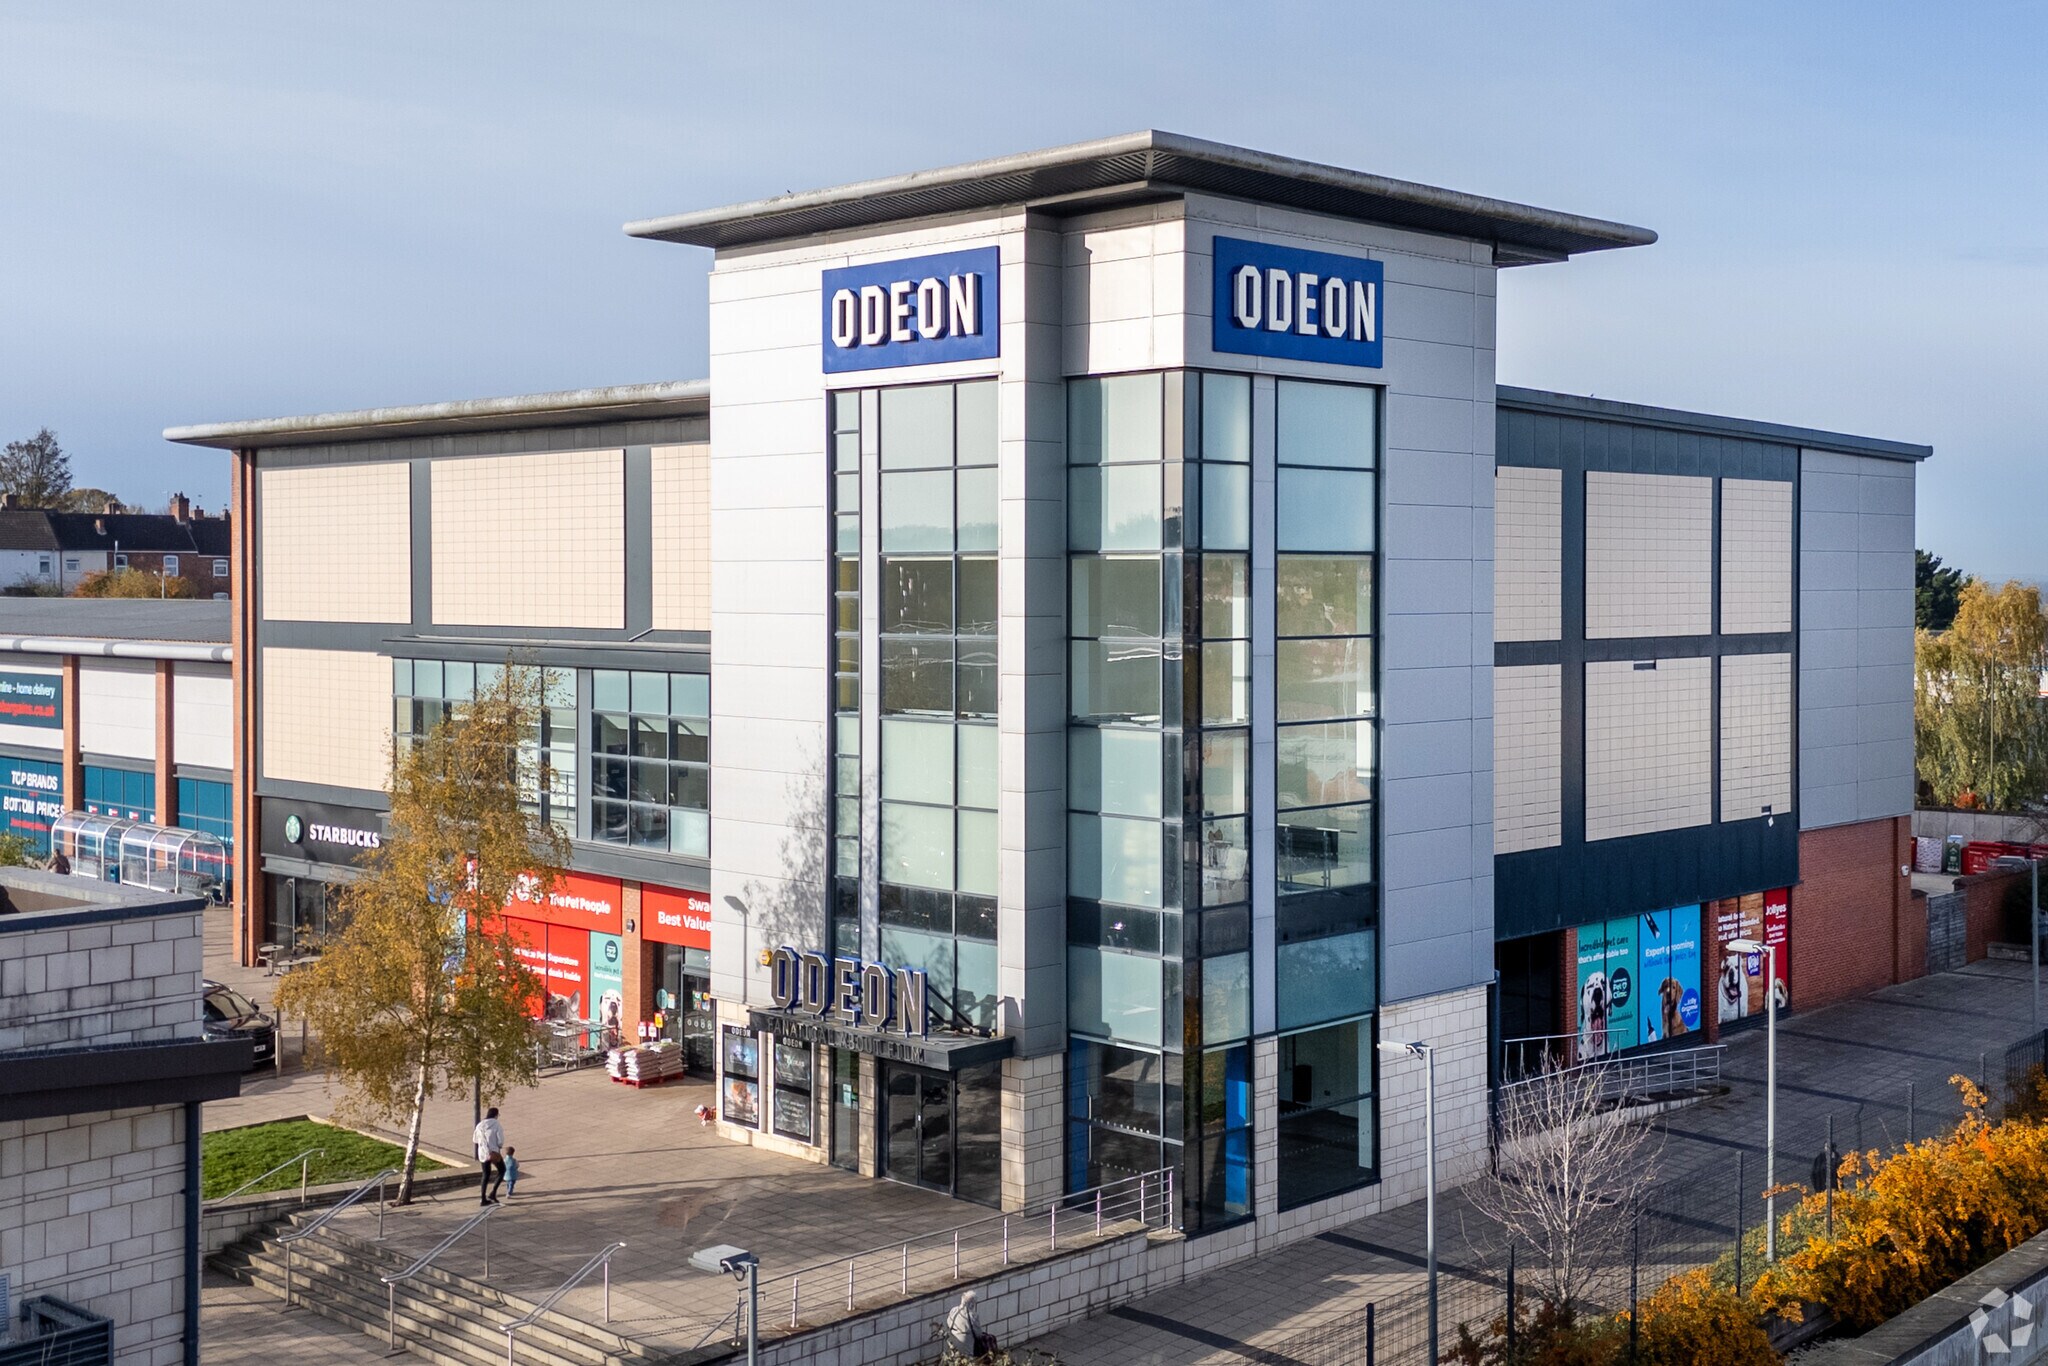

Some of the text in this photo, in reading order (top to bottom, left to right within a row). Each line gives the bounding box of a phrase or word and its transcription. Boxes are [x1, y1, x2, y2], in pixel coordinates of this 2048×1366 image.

[832, 272, 981, 348] ODEON
[1234, 265, 1375, 342] ODEON
[33, 683, 56, 699] delivery
[26, 773, 58, 790] BRANDS
[3, 796, 65, 818] BOTTOM PRICES
[309, 823, 380, 849] STARBUCKS
[565, 895, 579, 910] Pet
[580, 897, 611, 915] People
[658, 911, 711, 932] Best Value
[1645, 946, 1665, 958] Expert
[771, 946, 927, 1038] ODEON
[731, 1027, 751, 1037] ODEON
[768, 1018, 835, 1047] FANATICAL
[783, 1037, 803, 1049] ODEON
